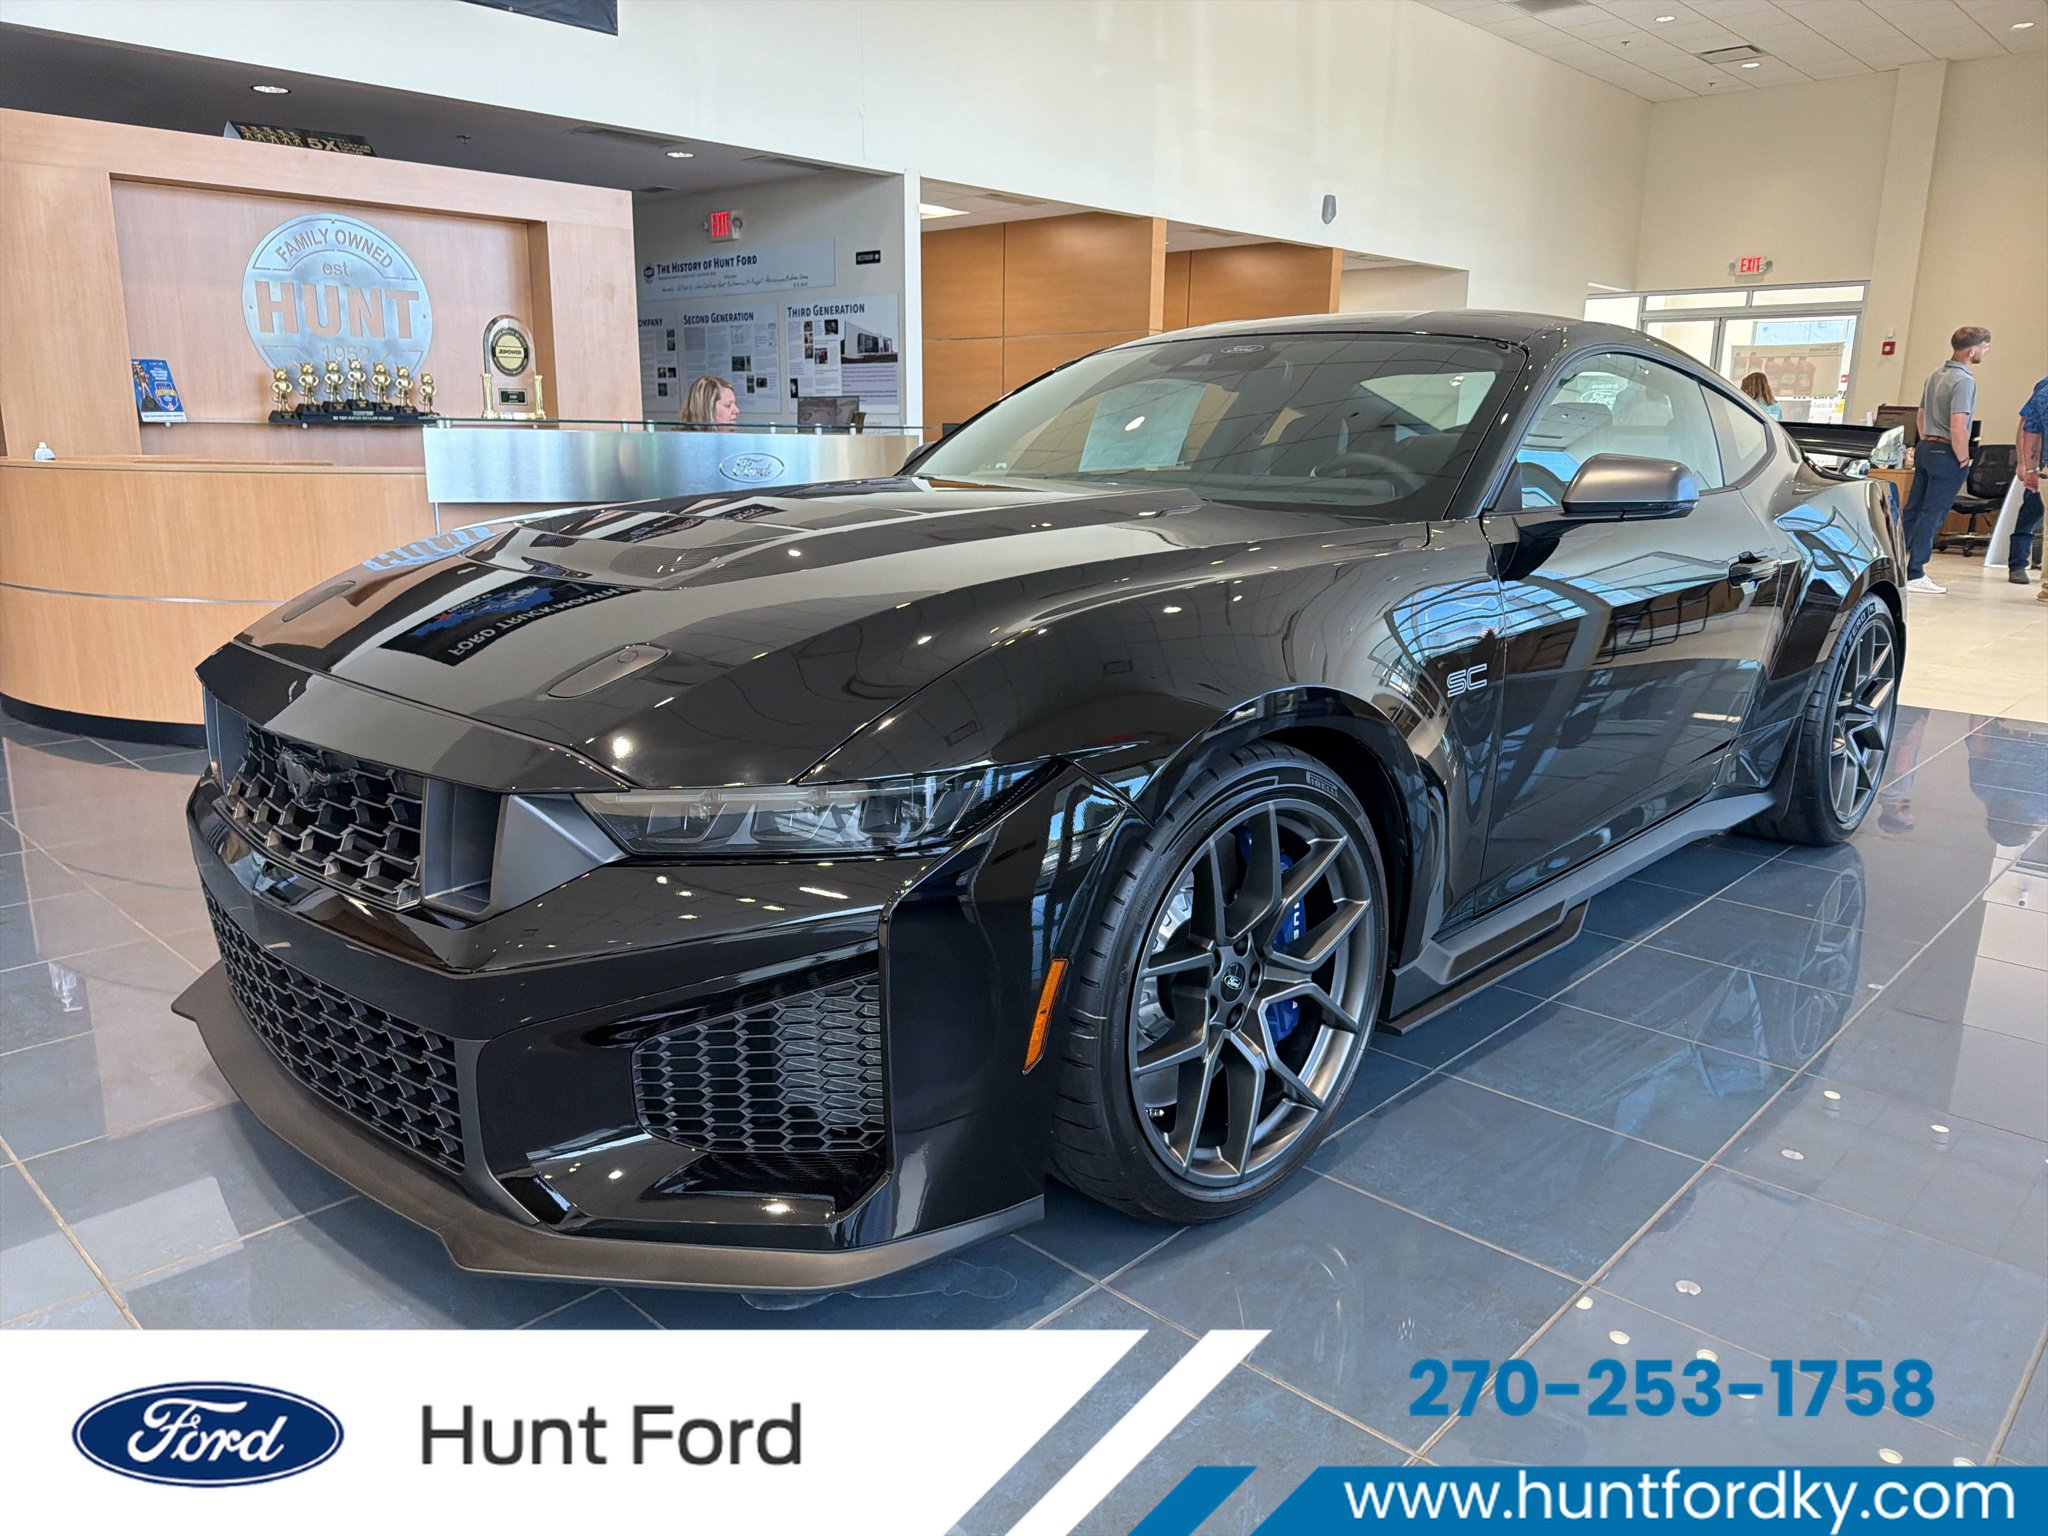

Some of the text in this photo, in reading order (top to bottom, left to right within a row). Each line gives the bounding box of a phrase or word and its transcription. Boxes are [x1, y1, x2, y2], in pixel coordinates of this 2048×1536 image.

[307, 137, 340, 151] 5X
[711, 211, 729, 237] EXIT
[274, 228, 393, 269] FAMILY OWNED
[322, 261, 353, 277] est.
[657, 255, 758, 275] THE HISTORY OF HUNT FORD
[1740, 256, 1761, 272] EXIT
[254, 281, 420, 340] HUNT
[684, 312, 754, 325] SECOND GENERATION
[787, 303, 865, 318] THIRD GENERATION
[638, 318, 663, 327] OMPANY
[1447, 663, 1487, 697] SC
[1306, 770, 1338, 798] PIRELLI
